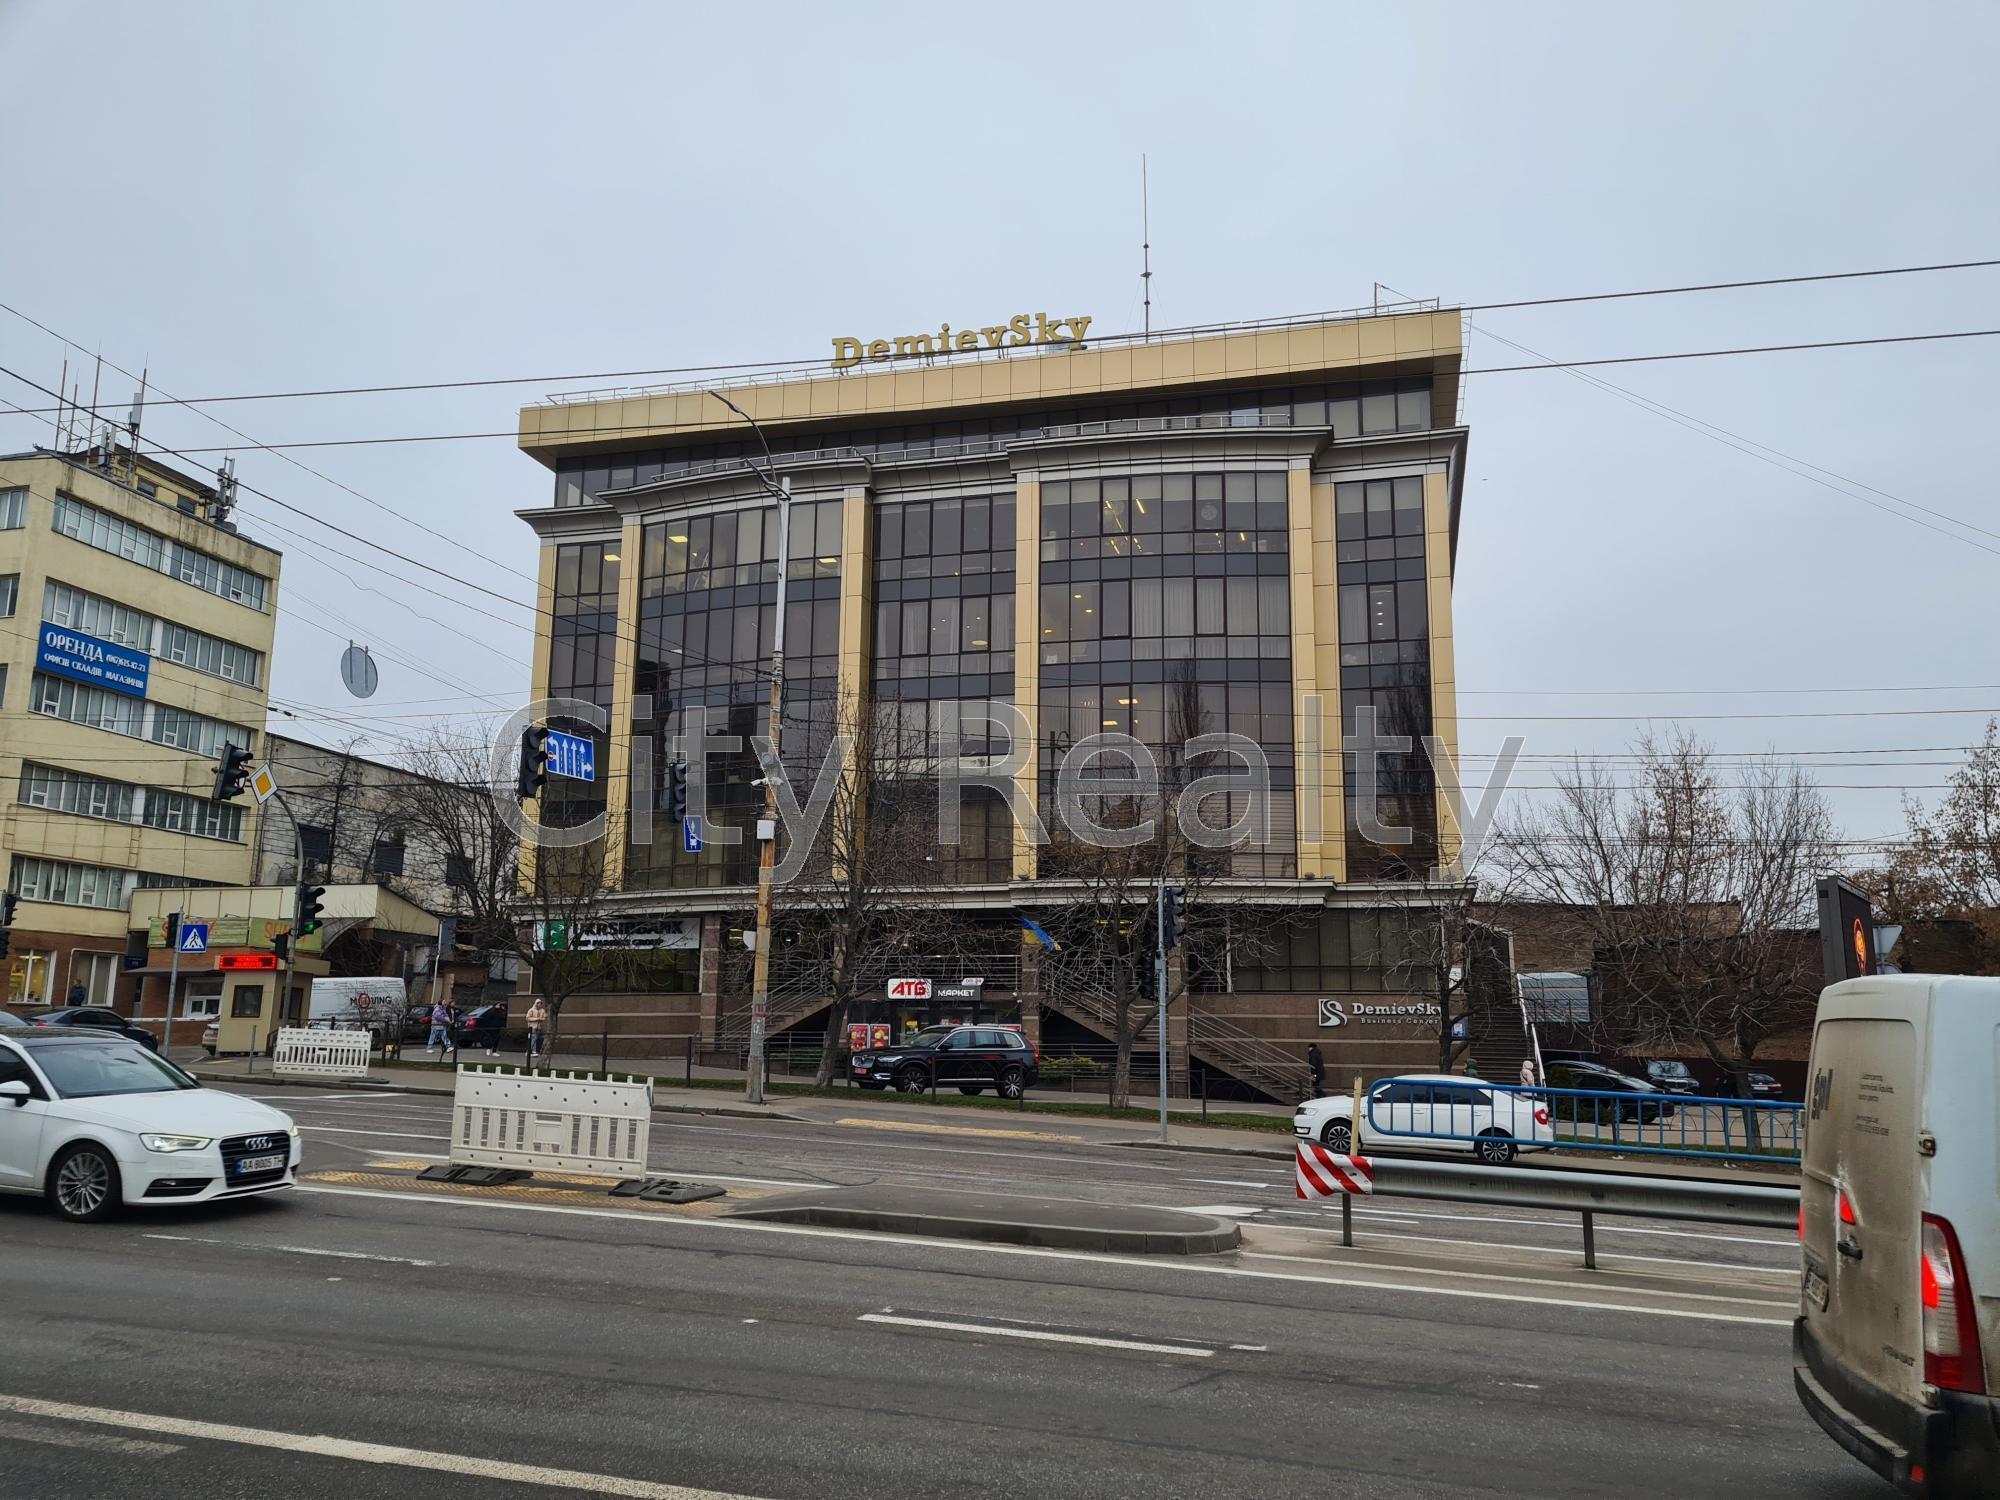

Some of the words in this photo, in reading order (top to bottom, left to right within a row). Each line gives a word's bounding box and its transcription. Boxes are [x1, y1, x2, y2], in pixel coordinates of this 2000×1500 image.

[831, 312, 1092, 369] DemievSky
[45, 631, 104, 662] ОРЕНДА
[937, 989, 975, 997] МАРКЕТ
